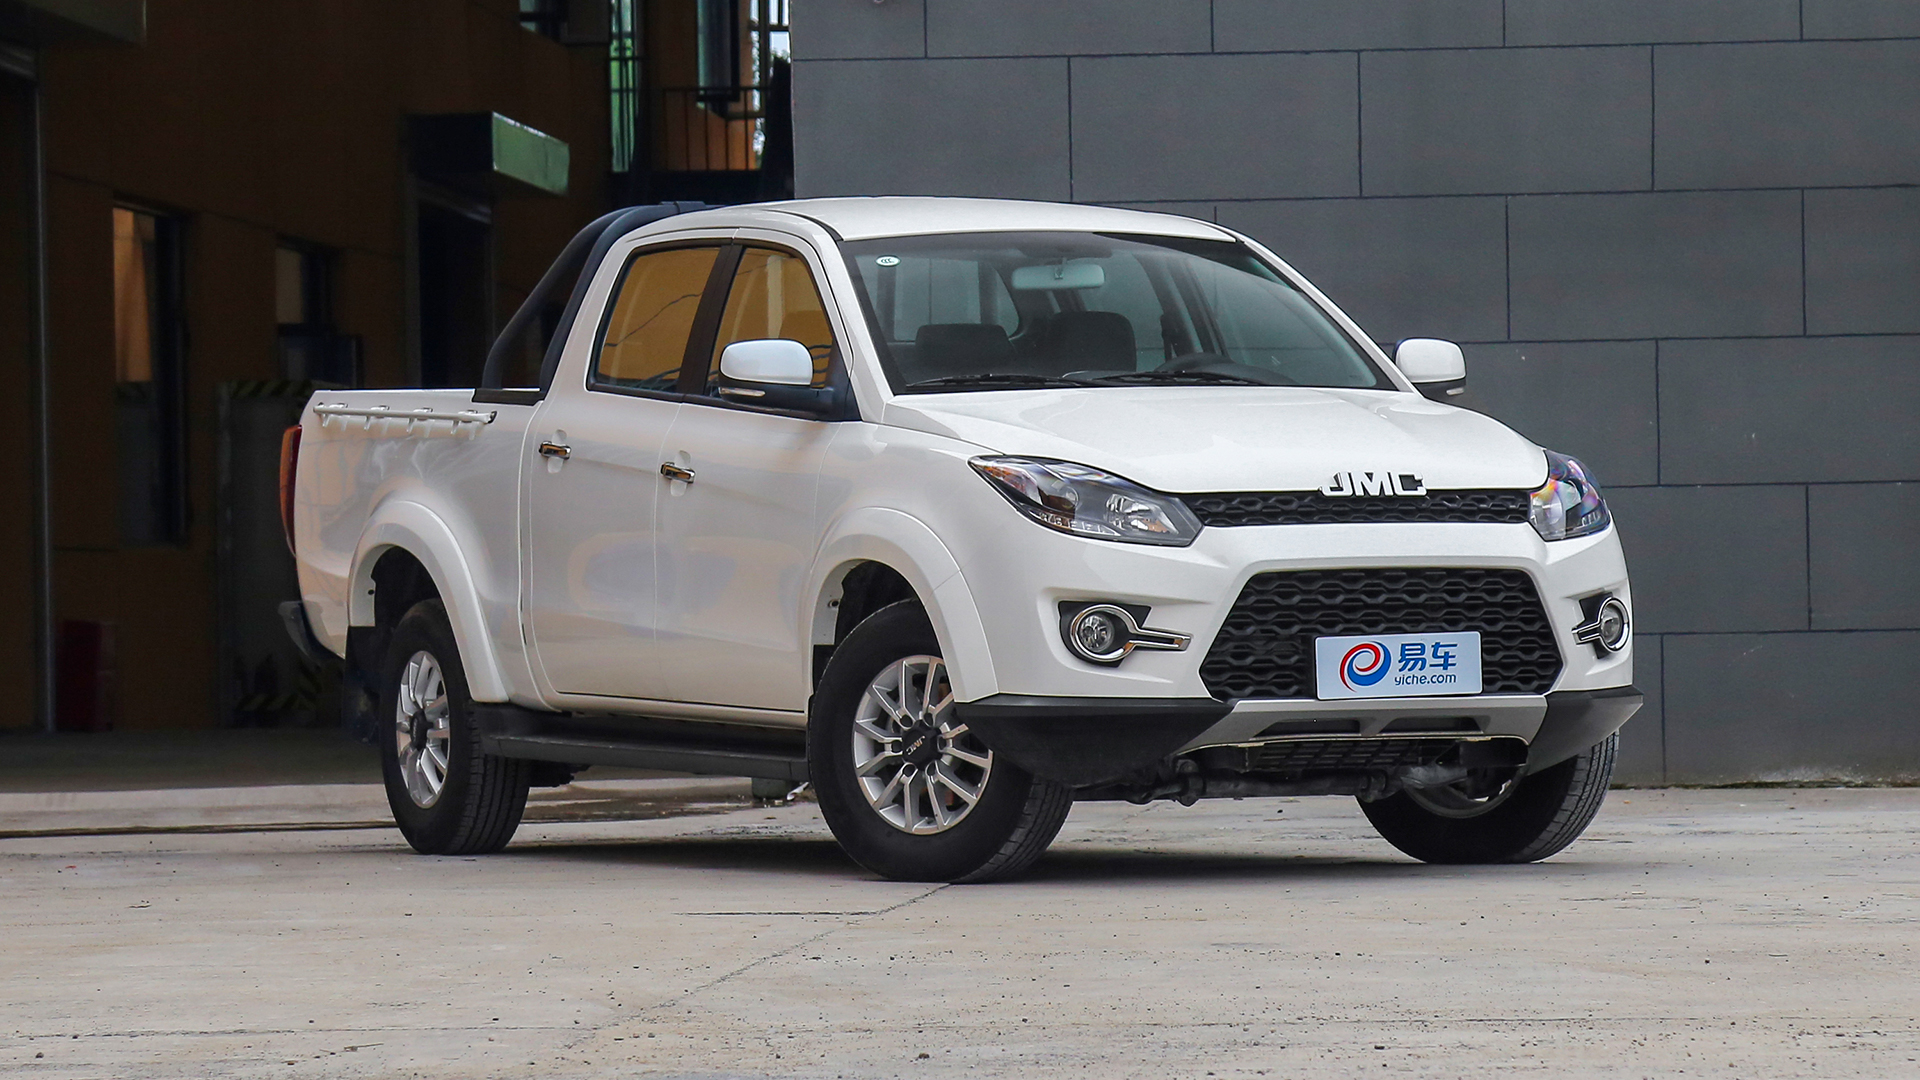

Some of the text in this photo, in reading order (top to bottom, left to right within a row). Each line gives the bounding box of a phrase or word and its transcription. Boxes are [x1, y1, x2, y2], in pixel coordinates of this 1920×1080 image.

[1319, 471, 1427, 497] JMC
[1398, 641, 1458, 671] 易车
[1394, 673, 1457, 686] yiche.com
